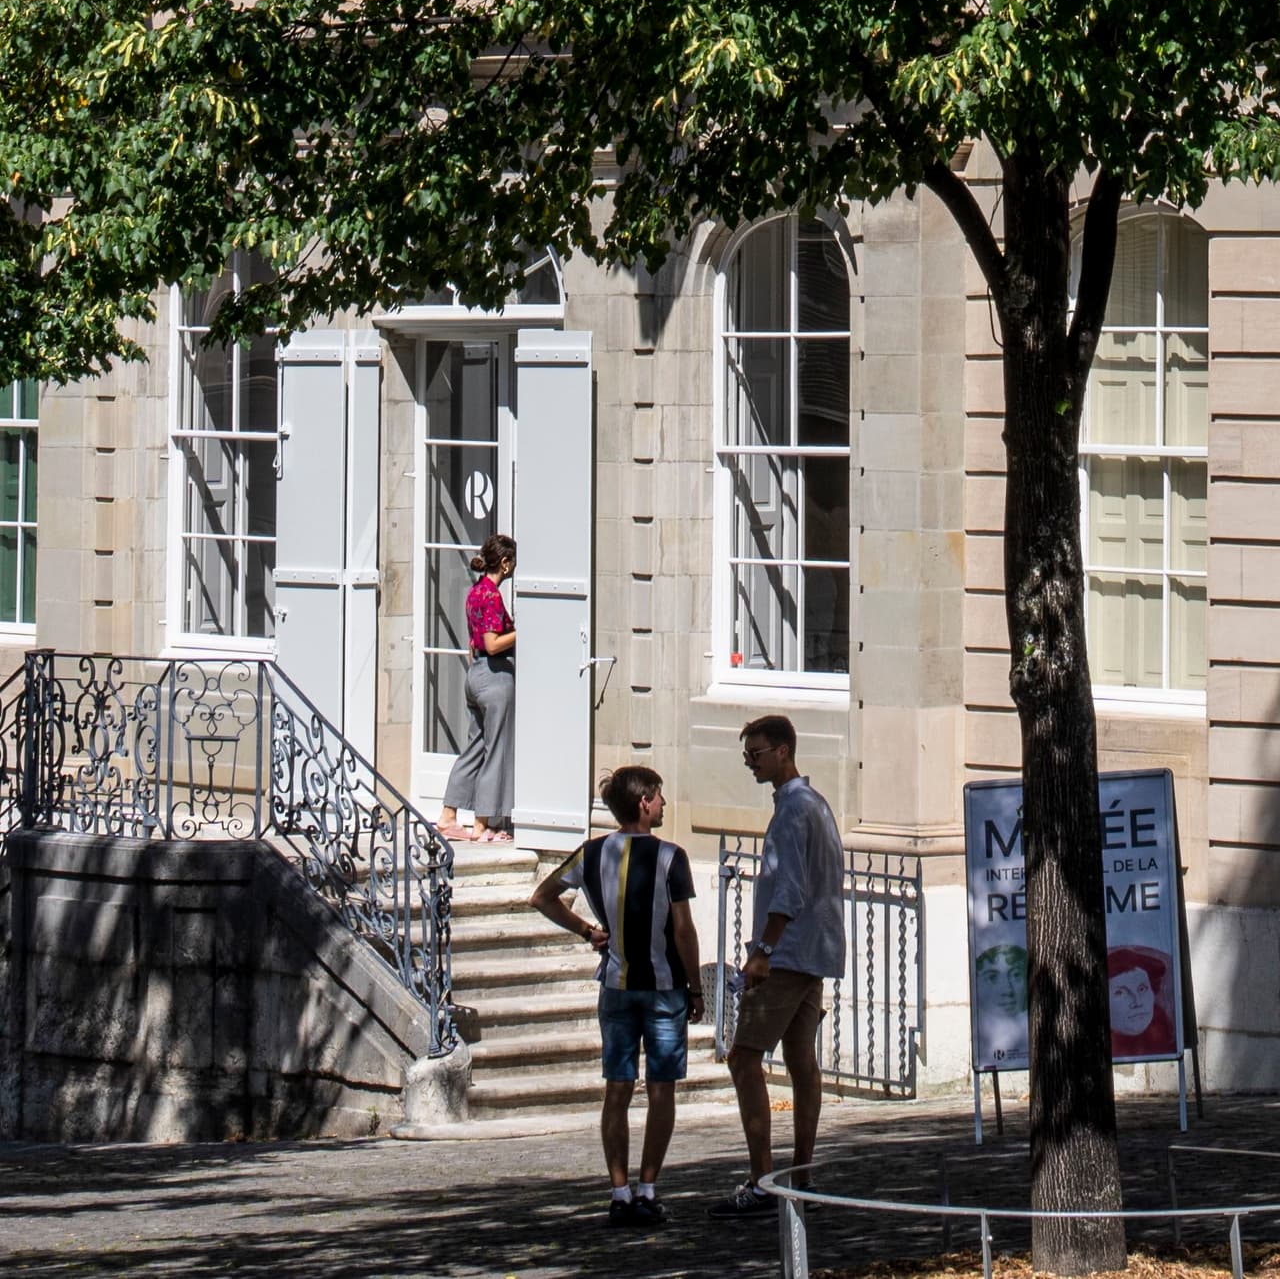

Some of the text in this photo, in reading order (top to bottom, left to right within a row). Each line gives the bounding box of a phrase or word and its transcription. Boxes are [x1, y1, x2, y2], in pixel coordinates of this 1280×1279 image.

[984, 800, 1158, 859] MÉE
[1113, 860, 1134, 873] DE
[1138, 857, 1158, 871] LA
[987, 882, 1161, 922] RÉME
